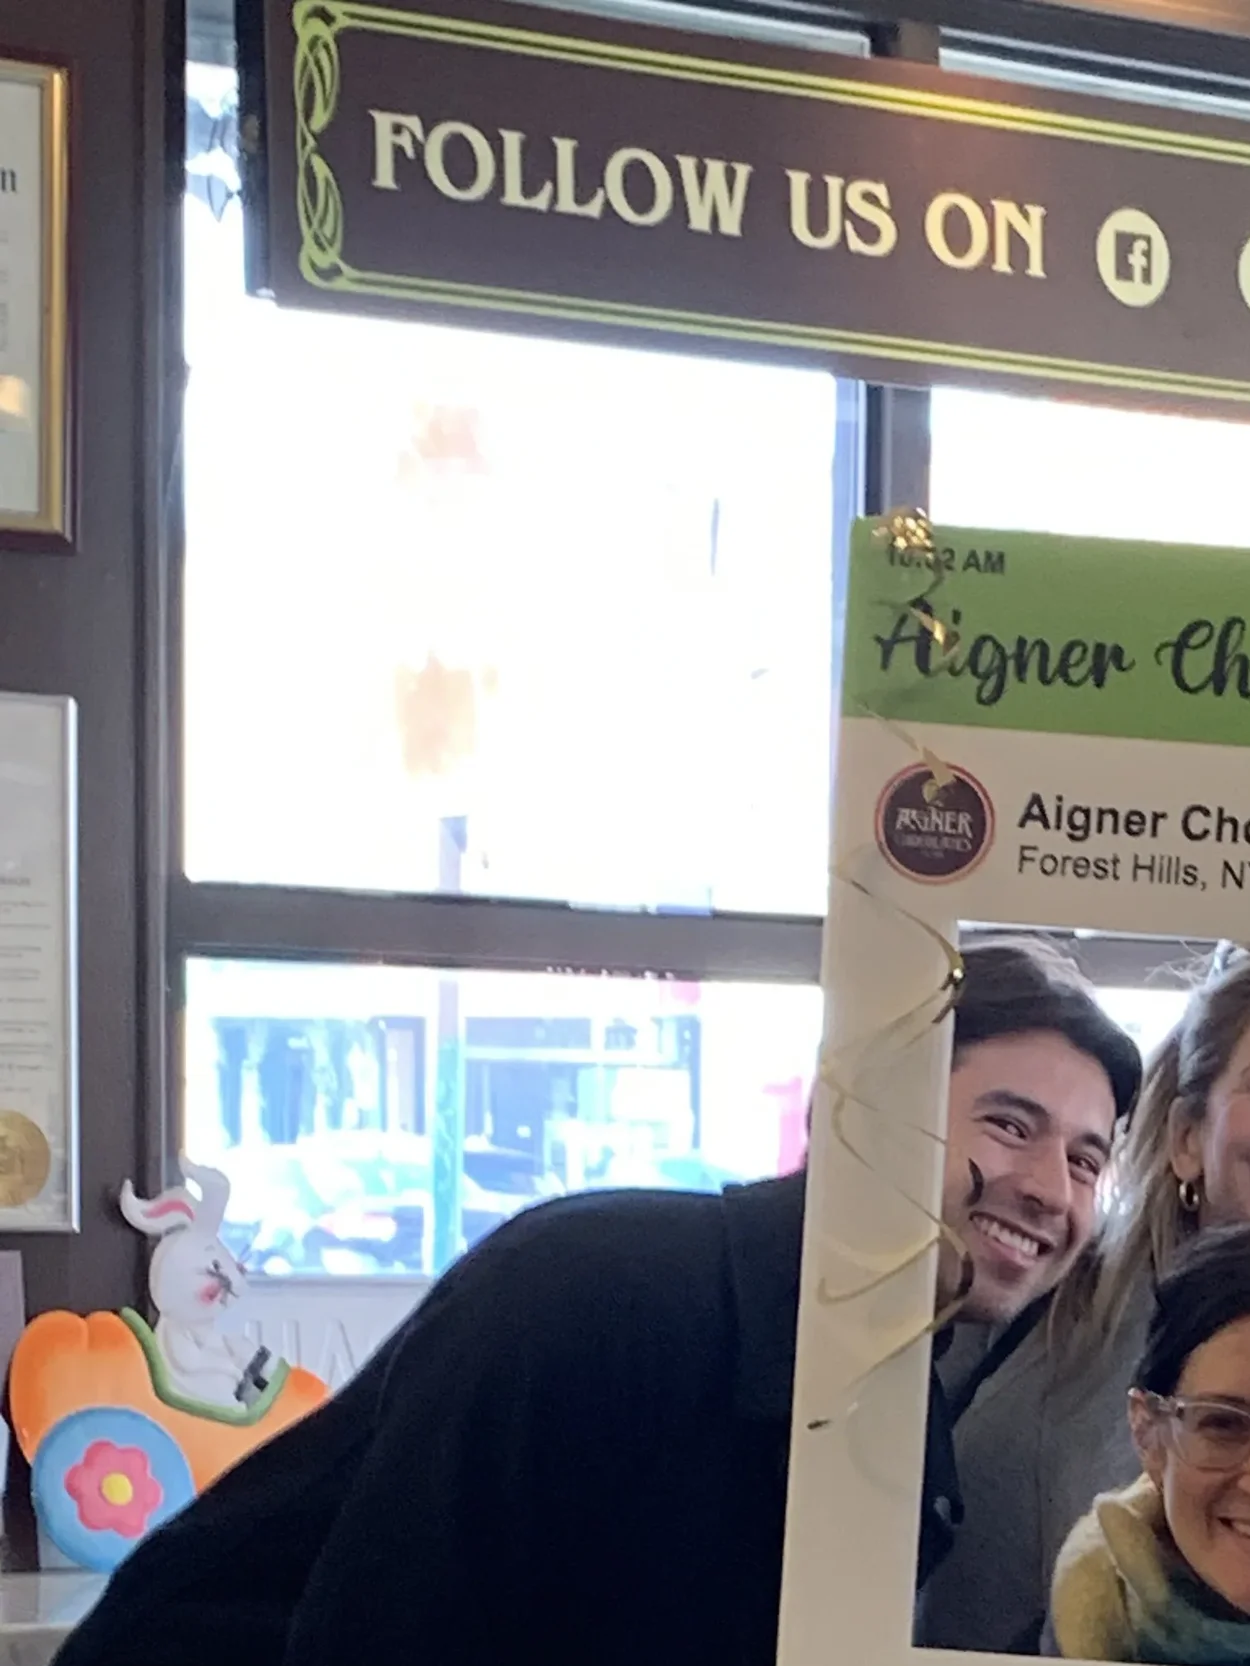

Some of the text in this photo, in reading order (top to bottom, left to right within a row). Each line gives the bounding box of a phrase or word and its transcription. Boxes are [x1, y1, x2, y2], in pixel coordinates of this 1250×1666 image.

[368, 110, 753, 237] FOLLOW
[786, 169, 898, 258] US
[924, 192, 1047, 278] ON
[962, 548, 1006, 575] AM
[873, 597, 1137, 707] Aigner
[1017, 793, 1168, 843] Aigner
[1018, 845, 1121, 882] Forest
[1131, 853, 1208, 892] Hills,
